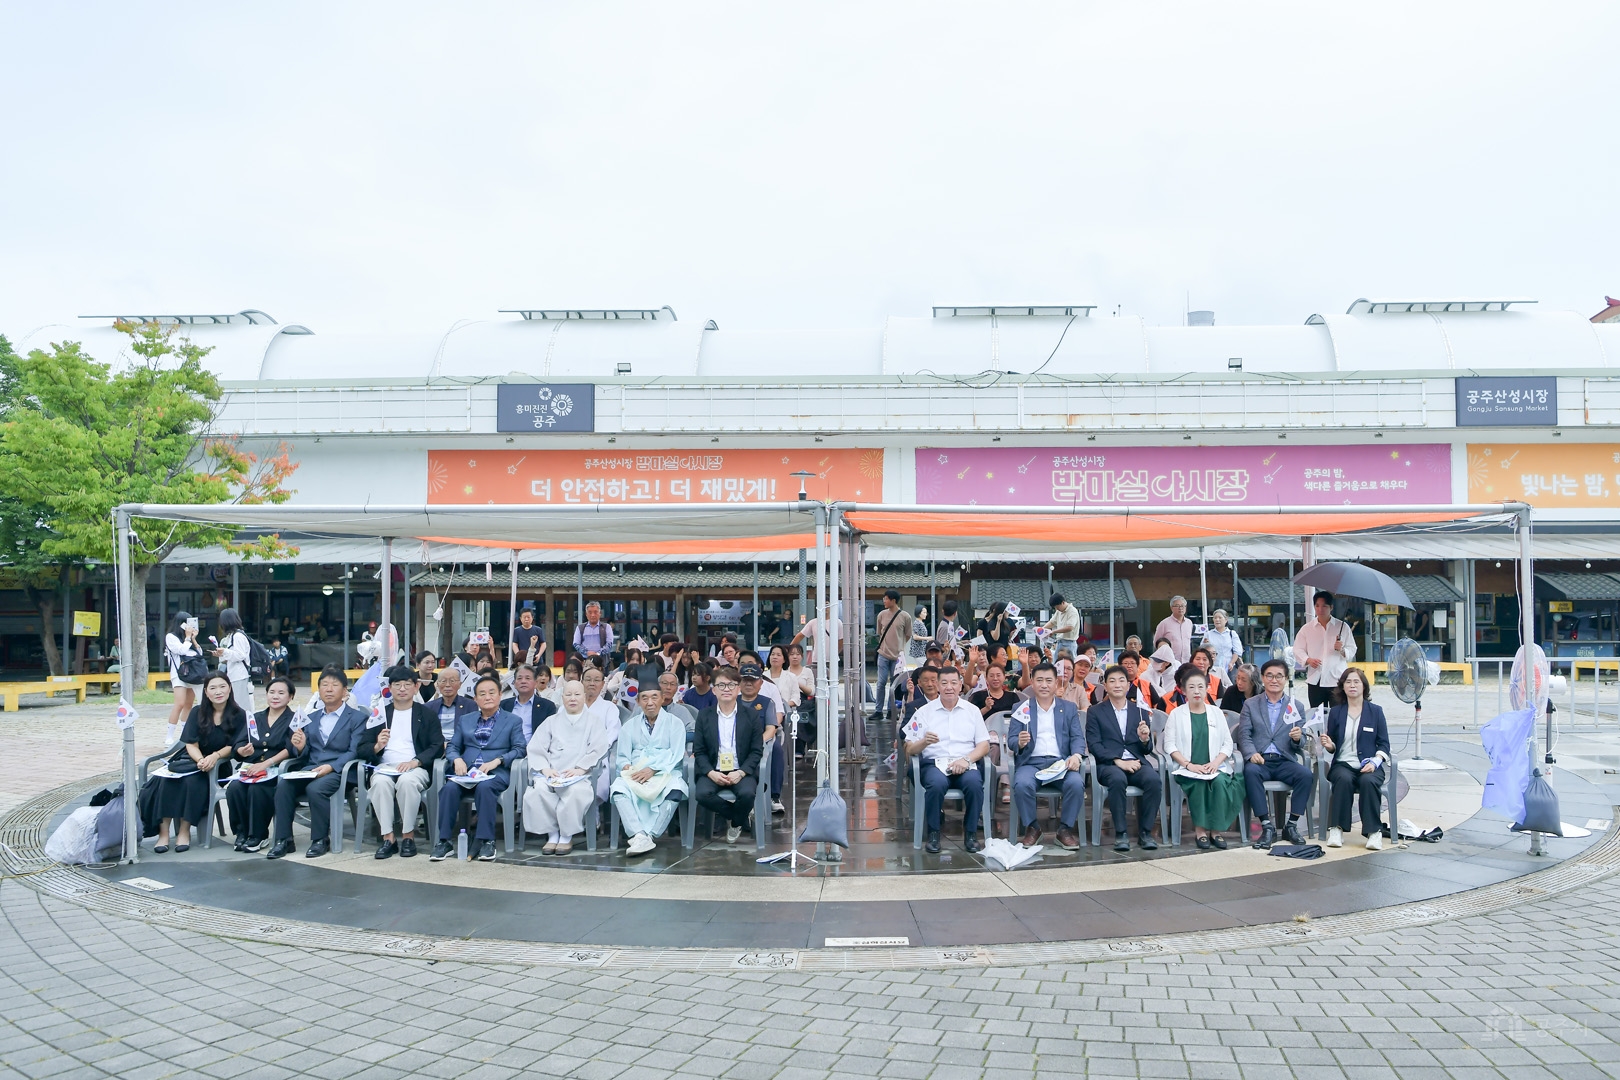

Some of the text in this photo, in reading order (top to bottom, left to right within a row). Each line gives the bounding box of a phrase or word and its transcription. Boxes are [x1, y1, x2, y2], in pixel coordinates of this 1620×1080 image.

[1466, 389, 1549, 405] 공주산성시장
[515, 404, 548, 415] 흥미진진
[1467, 405, 1492, 413] Gongju
[1494, 405, 1523, 413] Sansung
[532, 415, 557, 429] 공주
[584, 458, 633, 469] 공주산성시장
[1052, 456, 1106, 467] 공주산성시장
[1304, 468, 1345, 479] 공주의 밤,
[531, 478, 776, 503] 더 안전하고! 더 재밌게!
[1304, 480, 1407, 491] 색다른 즐거움으로 채우다
[1520, 474, 1579, 496] 빛나는
[1584, 474, 1609, 498] 밤,
